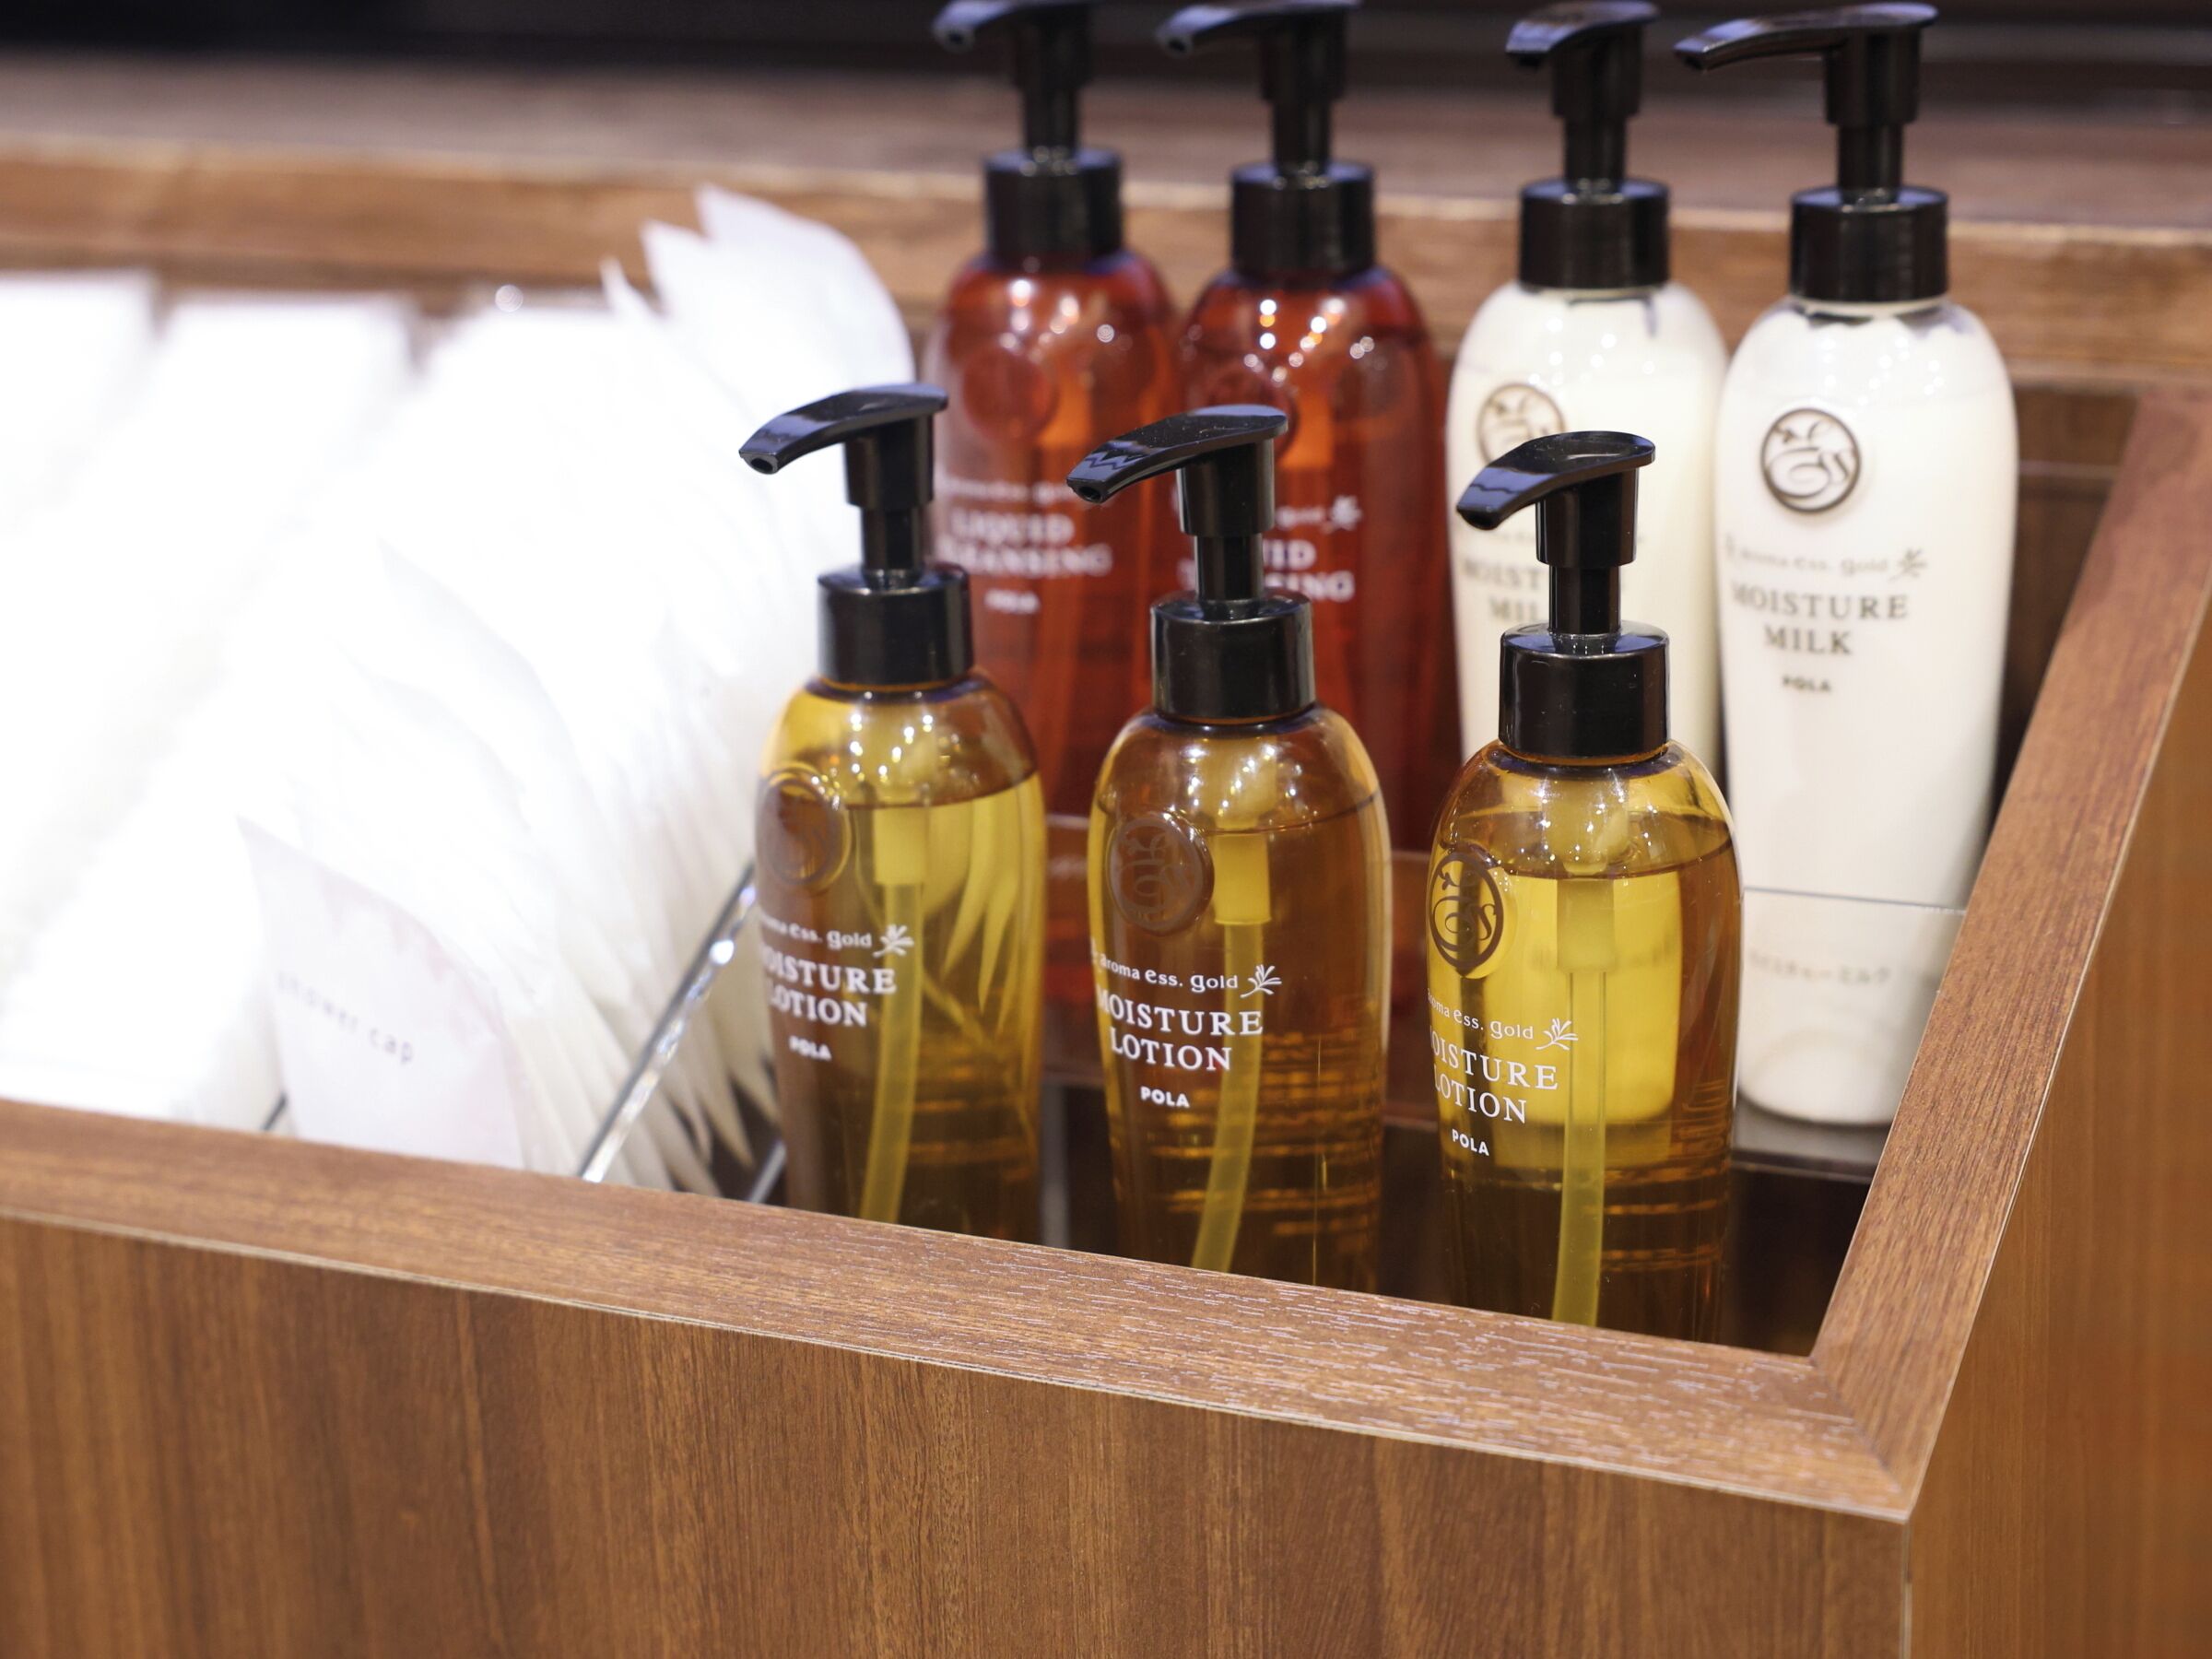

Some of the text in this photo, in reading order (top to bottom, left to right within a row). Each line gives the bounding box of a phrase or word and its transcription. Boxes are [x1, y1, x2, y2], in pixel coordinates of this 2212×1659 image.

[1731, 581, 1908, 620] MOISTURE
[1764, 624, 1853, 655] MILK
[1782, 675, 1831, 693] POLA
[827, 930, 872, 950] gold
[1145, 969, 1183, 987] ess.
[1190, 974, 1239, 994] gold
[1096, 982, 1264, 1036] MOISTURE
[1453, 1009, 1484, 1030] ess.
[1489, 1020, 1534, 1041] gold
[789, 1035, 832, 1061] POLA
[1110, 1026, 1232, 1072] LOTION
[1140, 1086, 1190, 1108] POLA
[1452, 1128, 1489, 1157] POLA
